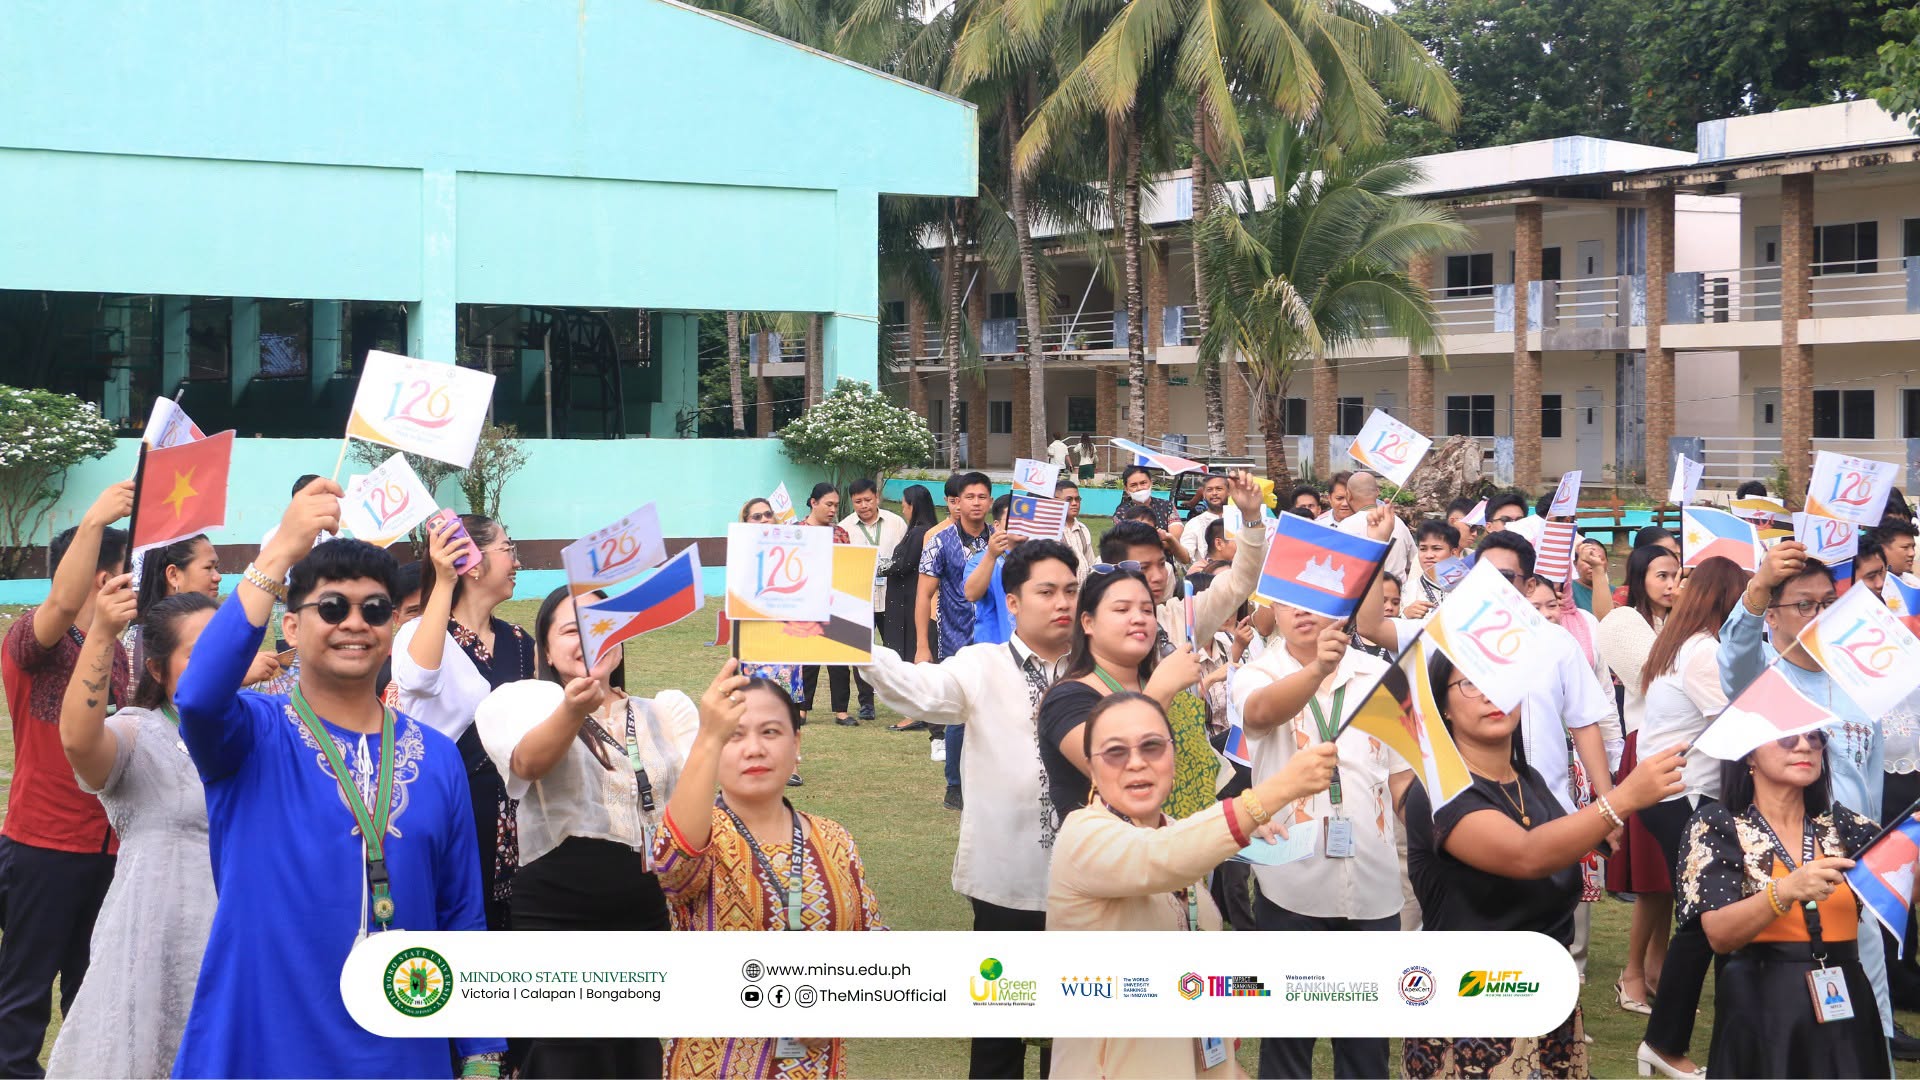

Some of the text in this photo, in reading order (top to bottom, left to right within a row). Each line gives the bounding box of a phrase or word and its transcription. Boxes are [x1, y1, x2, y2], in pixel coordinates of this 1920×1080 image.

[384, 380, 454, 428] 126
[1370, 431, 1408, 464] 126
[363, 480, 409, 530] 126
[1828, 472, 1872, 506] 126
[587, 530, 641, 577] 126
[755, 545, 808, 598] 126
[1456, 600, 1526, 664] 126
[1831, 617, 1900, 678] 126
[791, 827, 802, 875] MINSU
[1758, 816, 1787, 855] UNIVERSITY
[1803, 835, 1814, 866] MIN
